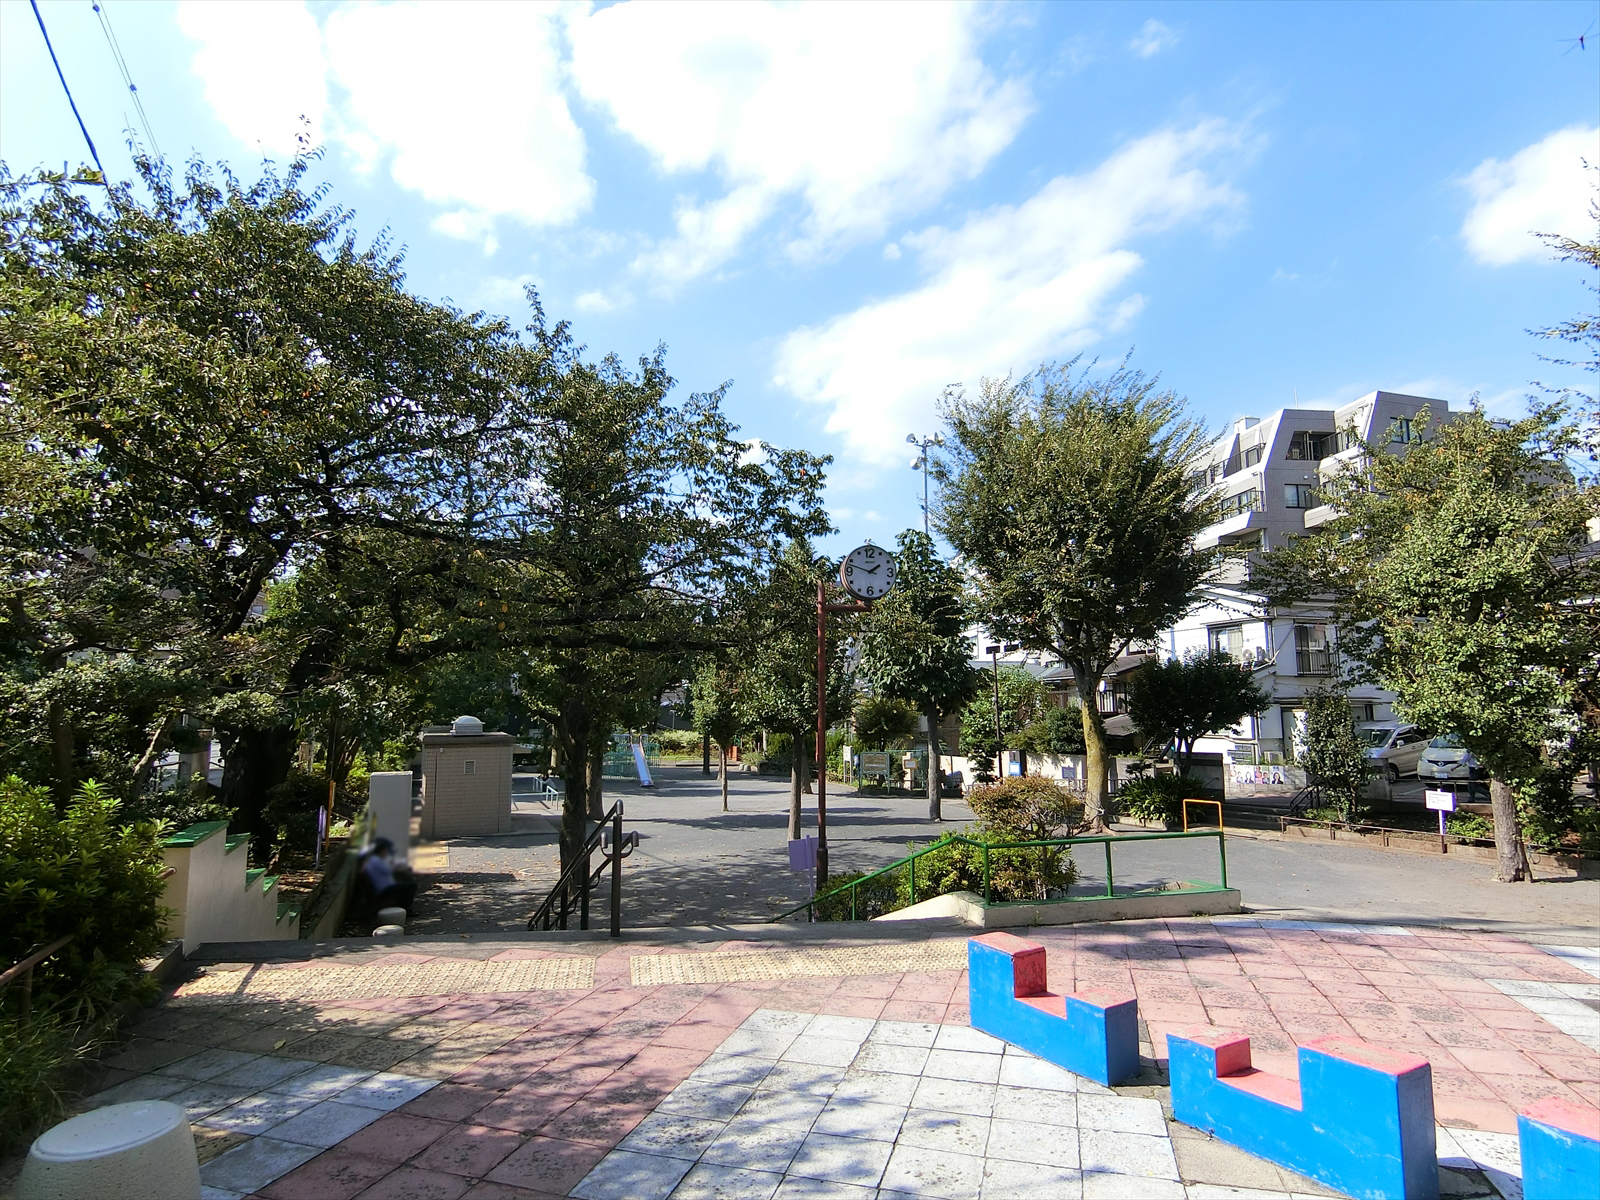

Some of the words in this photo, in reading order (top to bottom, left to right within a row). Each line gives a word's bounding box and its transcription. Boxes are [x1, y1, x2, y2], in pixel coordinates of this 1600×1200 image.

[864, 547, 875, 559] 12
[846, 566, 854, 577] 9
[886, 567, 894, 578] 3
[866, 585, 874, 597] 6
